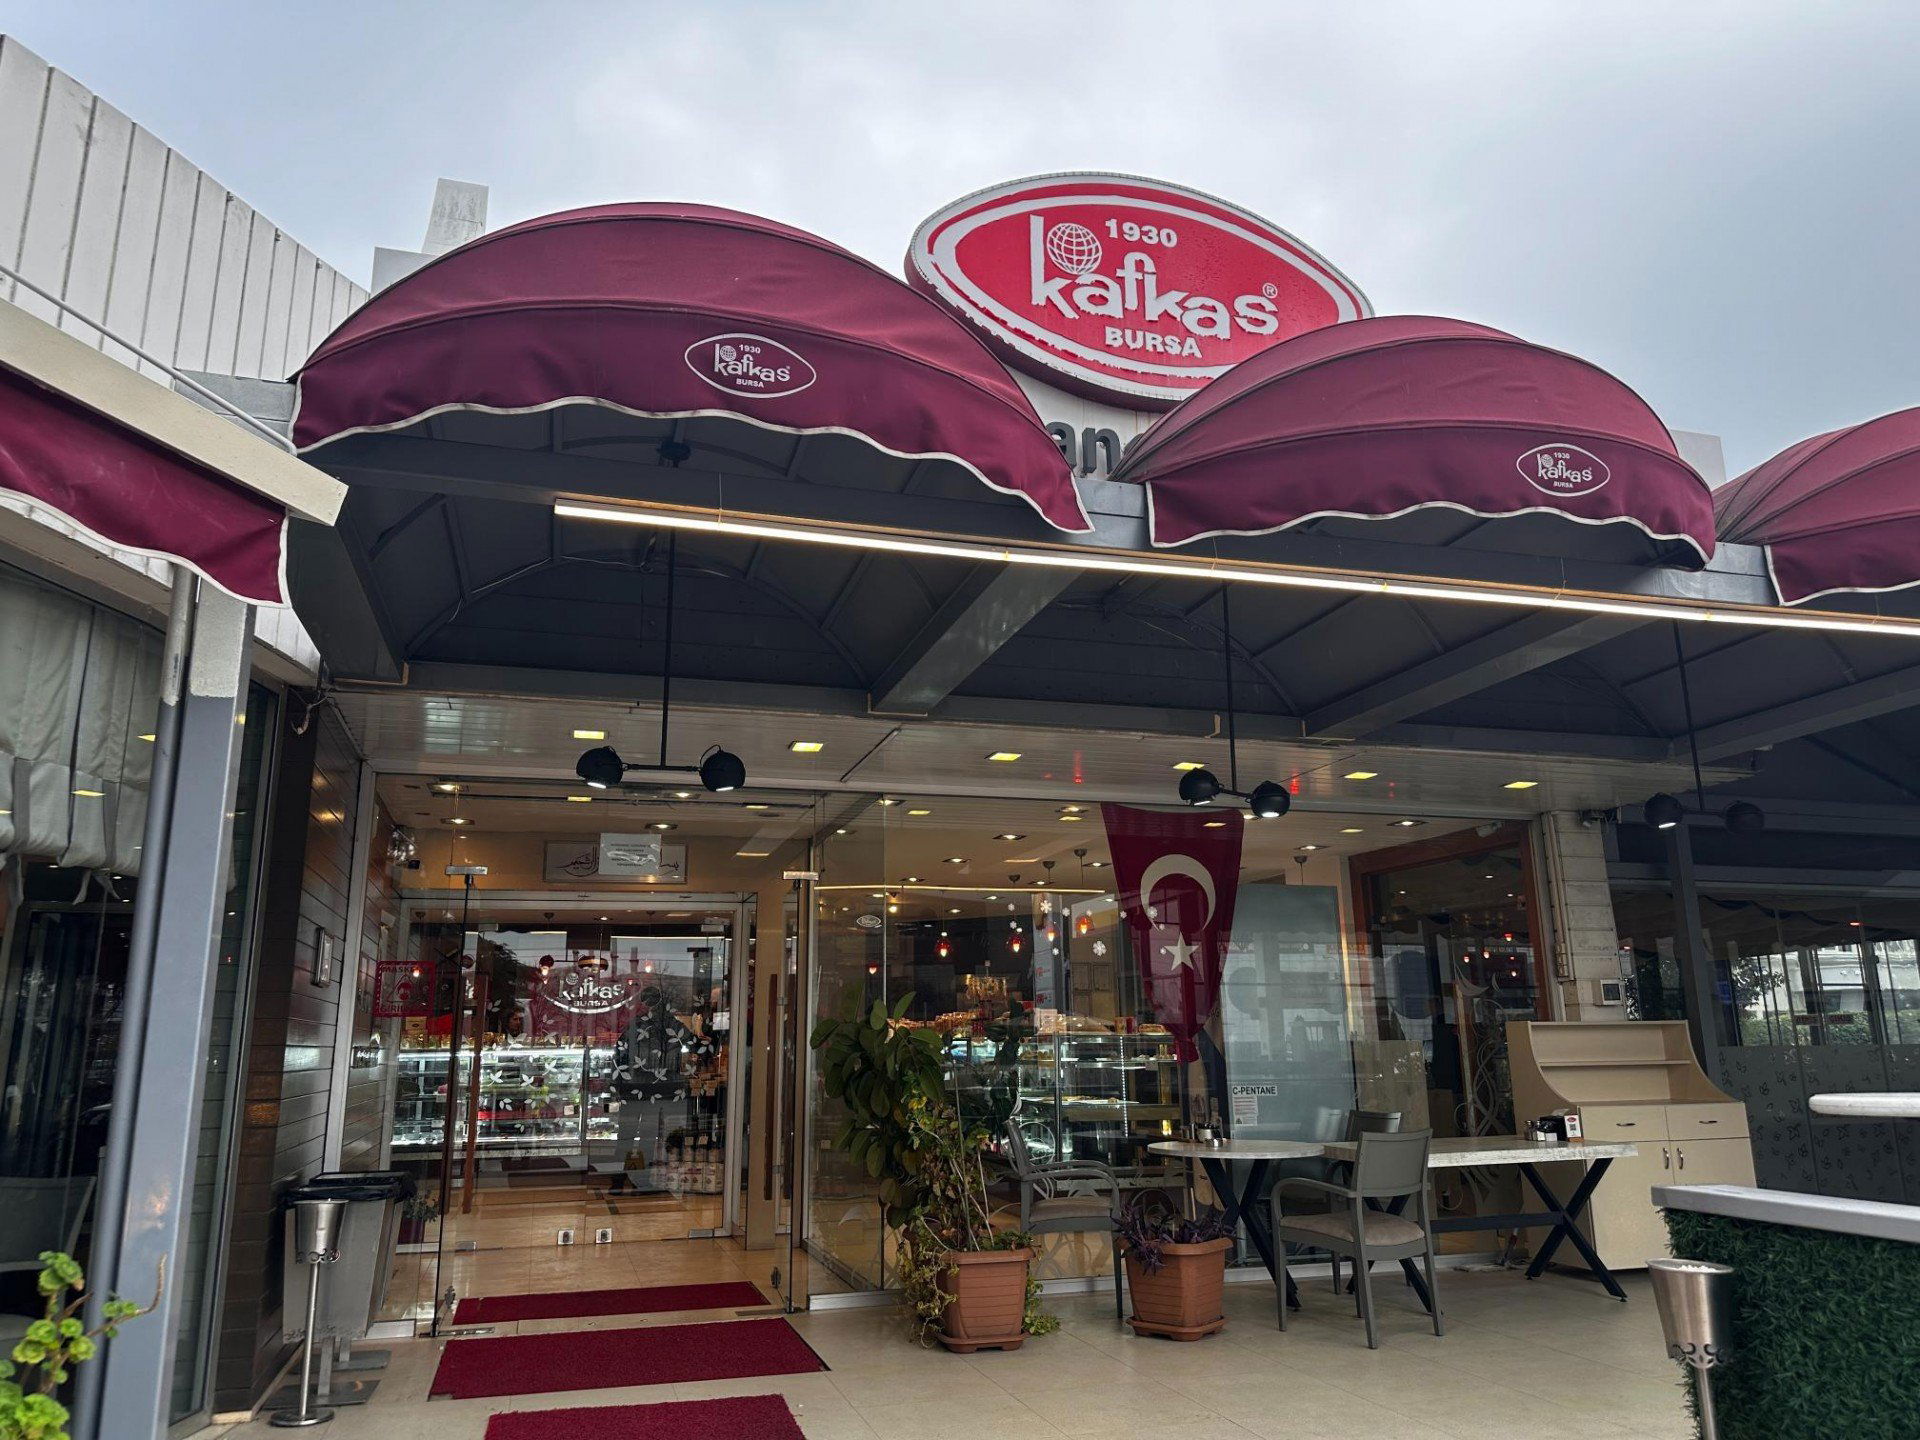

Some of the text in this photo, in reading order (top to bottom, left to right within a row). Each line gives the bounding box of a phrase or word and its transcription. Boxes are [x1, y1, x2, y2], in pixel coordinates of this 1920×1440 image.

[1105, 218, 1178, 248] 1930
[1030, 214, 1279, 340] kafkas
[739, 344, 761, 354] 1930
[1105, 326, 1203, 359] BURSA
[714, 344, 790, 382] kafkas
[736, 379, 764, 388] BURSA
[1537, 453, 1593, 483] kafkas
[1232, 1086, 1277, 1095] C-PENTANE
